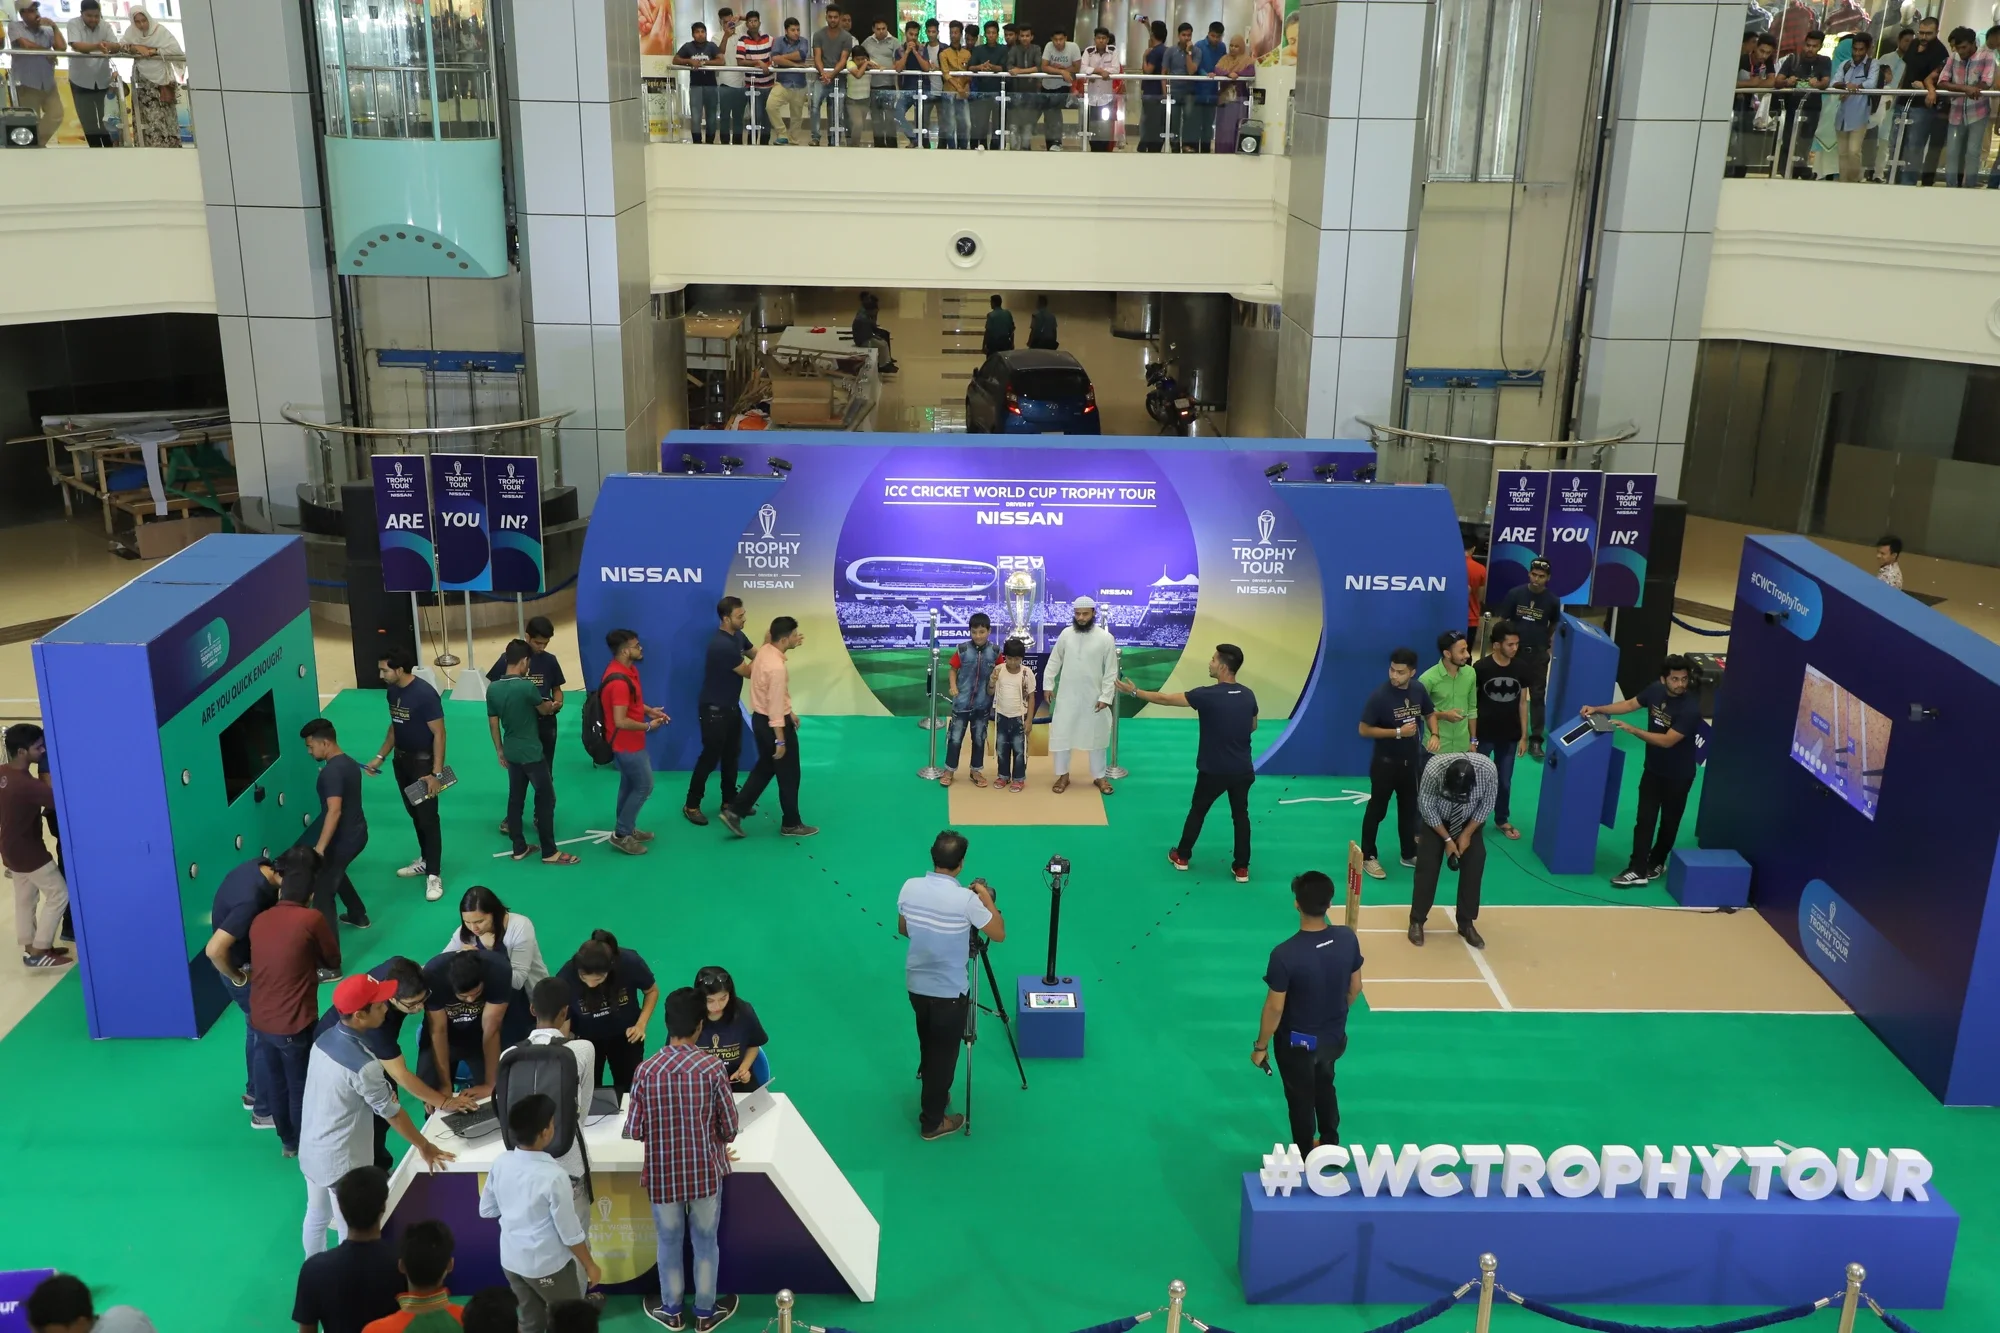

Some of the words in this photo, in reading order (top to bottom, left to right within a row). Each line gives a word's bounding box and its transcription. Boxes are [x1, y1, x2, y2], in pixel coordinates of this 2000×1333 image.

[885, 485, 907, 497] ICC
[911, 486, 970, 498] CRICKET
[973, 486, 1025, 498] WORLD
[1028, 487, 1056, 499] CUP
[1061, 487, 1116, 499] TROPHY
[1118, 488, 1156, 500] TOUR
[385, 513, 424, 529] ARE
[442, 512, 480, 527] YOU
[500, 515, 528, 529] IN?
[977, 511, 1063, 525] NISSAN
[1498, 527, 1537, 542] ARE
[1552, 527, 1589, 542] YOU
[1609, 530, 1639, 545] IN?
[738, 541, 800, 555] TROPHY
[1232, 547, 1296, 560] TROPHY
[745, 556, 790, 568] TOUR
[1240, 562, 1284, 574] TOUR
[601, 566, 702, 583] NISSAN
[743, 581, 794, 589] NISSAN
[1237, 586, 1286, 594] NISSAN
[1345, 575, 1446, 592] NISSAN
[1751, 572, 1809, 616] #CWCTrophyTour
[202, 703, 215, 726] ARE
[216, 690, 231, 711] YOU
[232, 673, 252, 699] QUICK
[254, 646, 283, 681] ENOUGH?
[1810, 914, 1832, 940] TROPHY
[1832, 937, 1848, 958] TOUR
[1816, 939, 1836, 962] NISSAN
[1260, 1142, 1933, 1203] #CWCTROPHYTOUR
[588, 1232, 613, 1242] PHY
